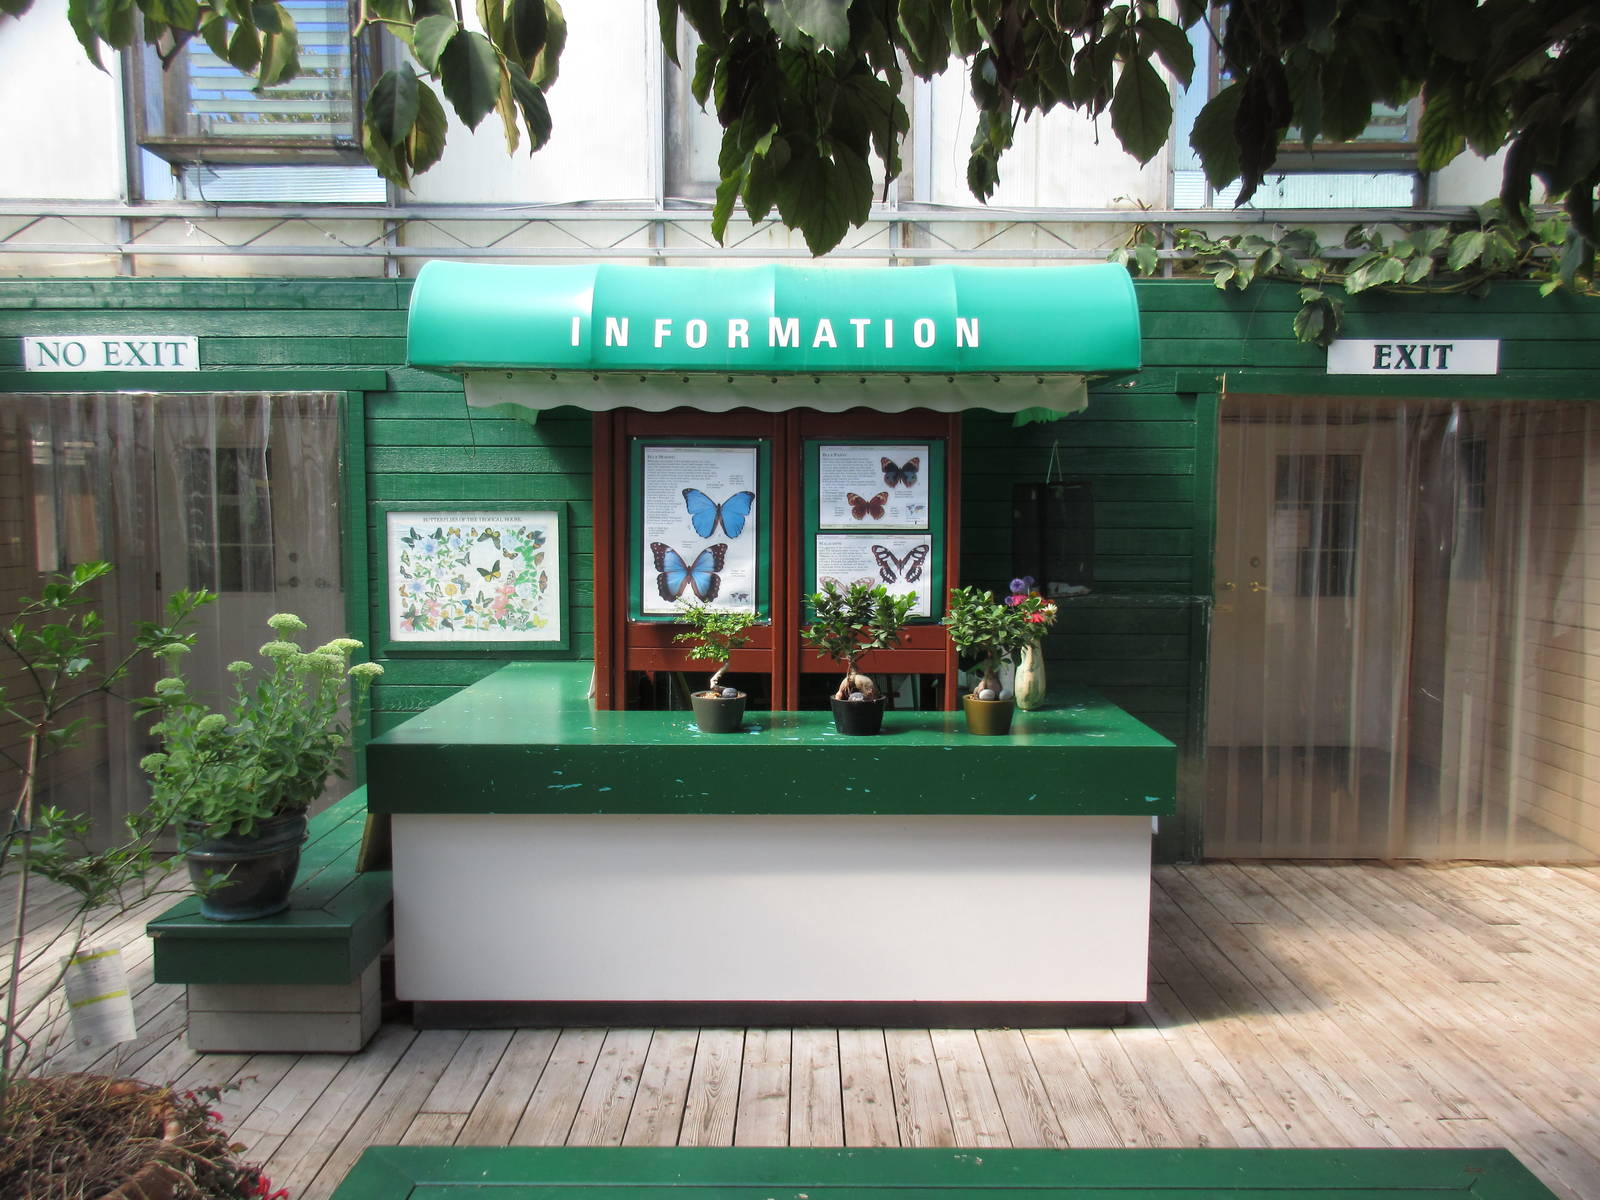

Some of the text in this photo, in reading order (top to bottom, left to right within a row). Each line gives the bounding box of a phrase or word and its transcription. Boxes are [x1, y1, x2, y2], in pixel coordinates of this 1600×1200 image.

[571, 317, 980, 348] INFORMATION
[36, 341, 189, 367] NO EXIT
[1373, 344, 1453, 370] EXIT
